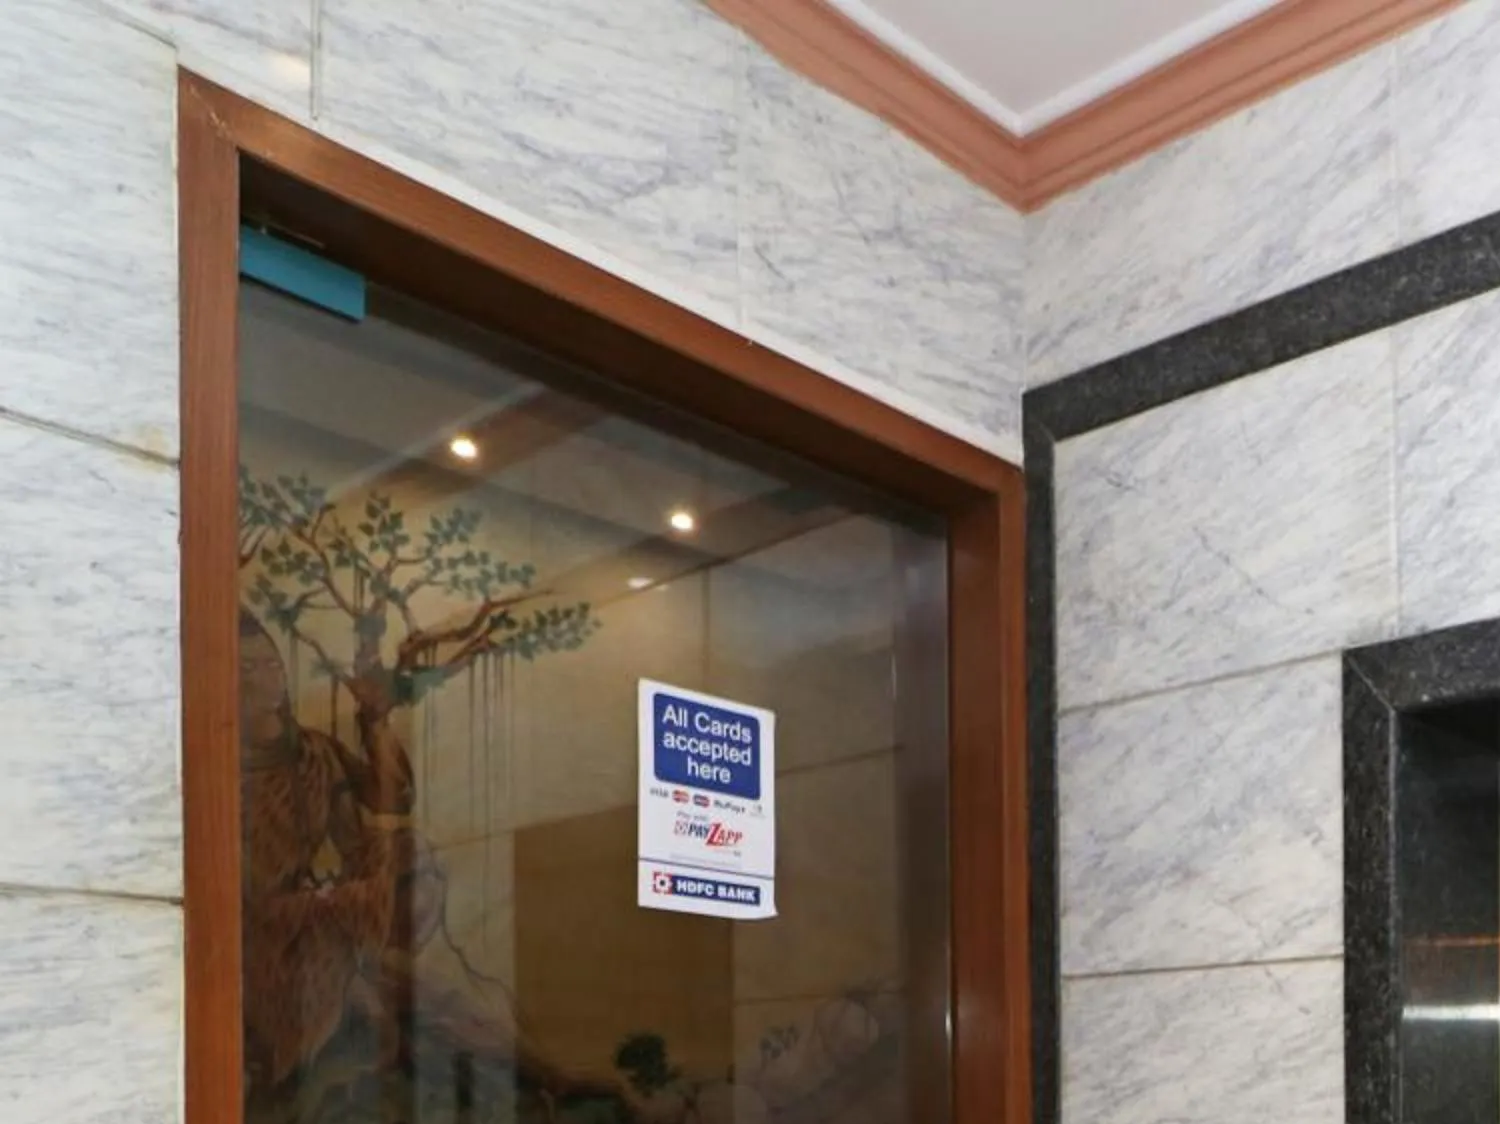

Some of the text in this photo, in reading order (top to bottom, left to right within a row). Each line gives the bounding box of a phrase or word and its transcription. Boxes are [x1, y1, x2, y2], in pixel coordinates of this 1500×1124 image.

[662, 703, 753, 744] All Cards
[662, 731, 752, 766] accepted
[686, 756, 732, 784] here
[676, 880, 757, 903] HDFC BANK
